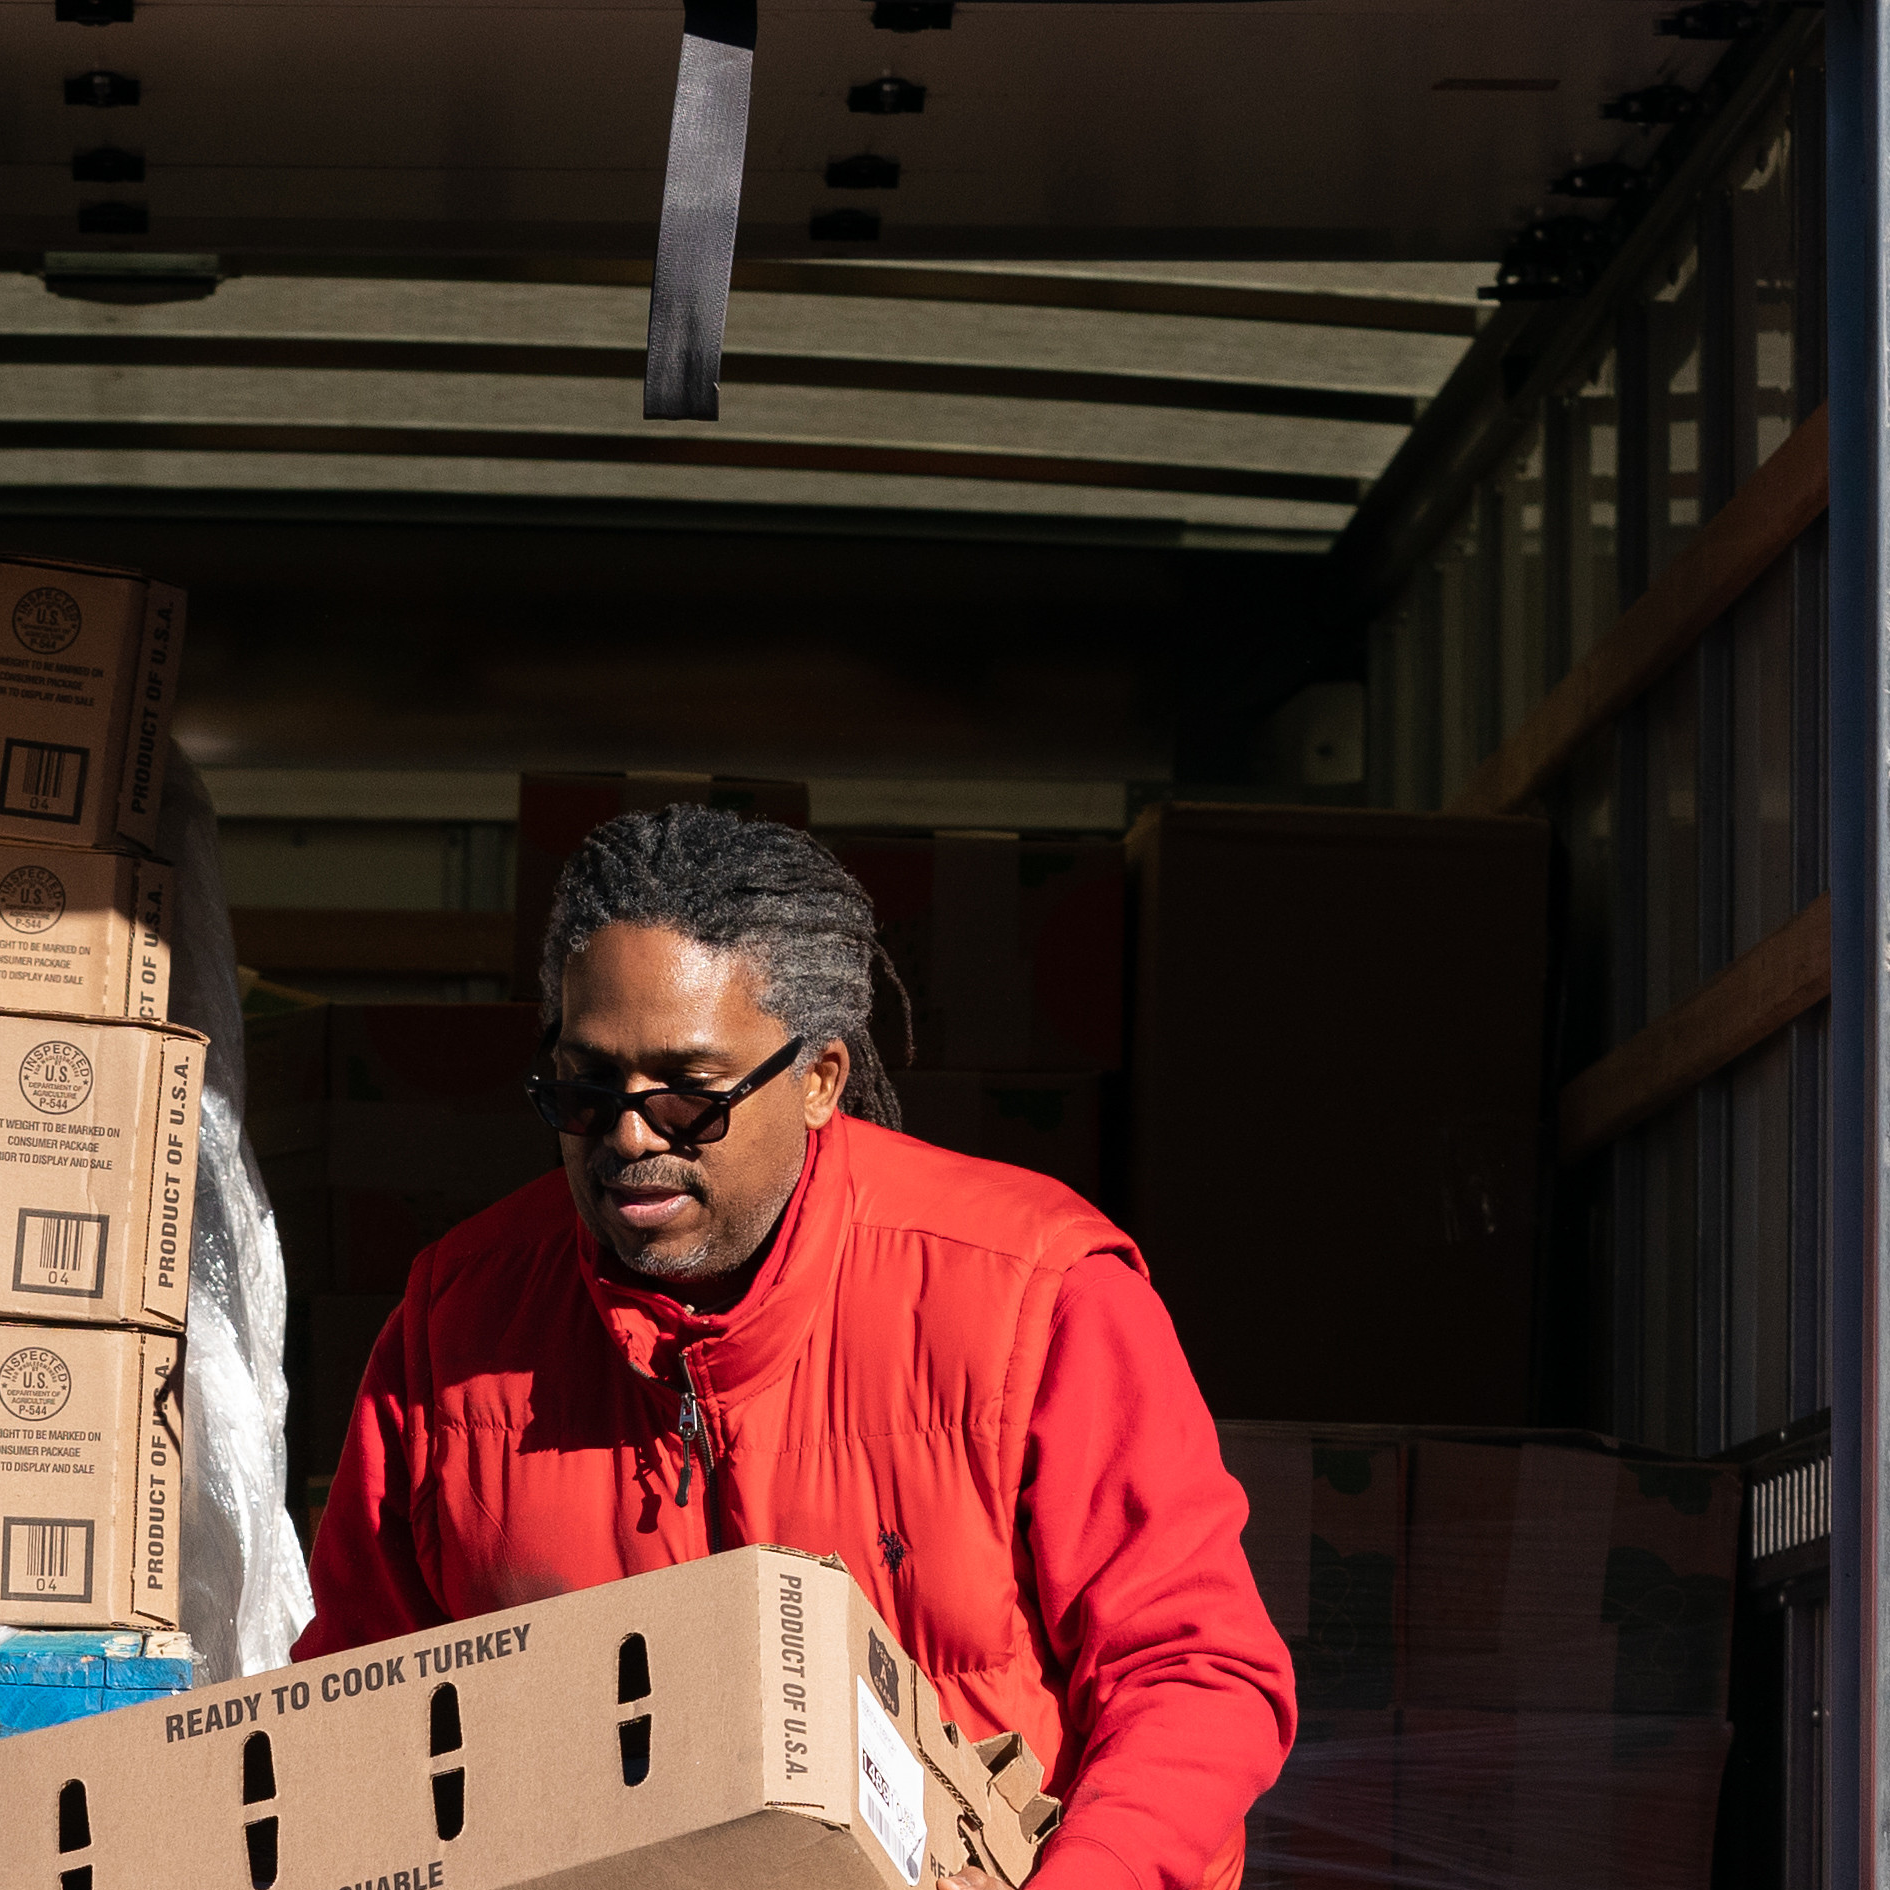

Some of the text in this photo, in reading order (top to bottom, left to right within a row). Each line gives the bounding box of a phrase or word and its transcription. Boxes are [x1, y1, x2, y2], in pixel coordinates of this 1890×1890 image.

[166, 1624, 530, 1743] READY TO COOK TURKEY
[780, 1574, 807, 1779] PRODUCT OF U.S.A.
